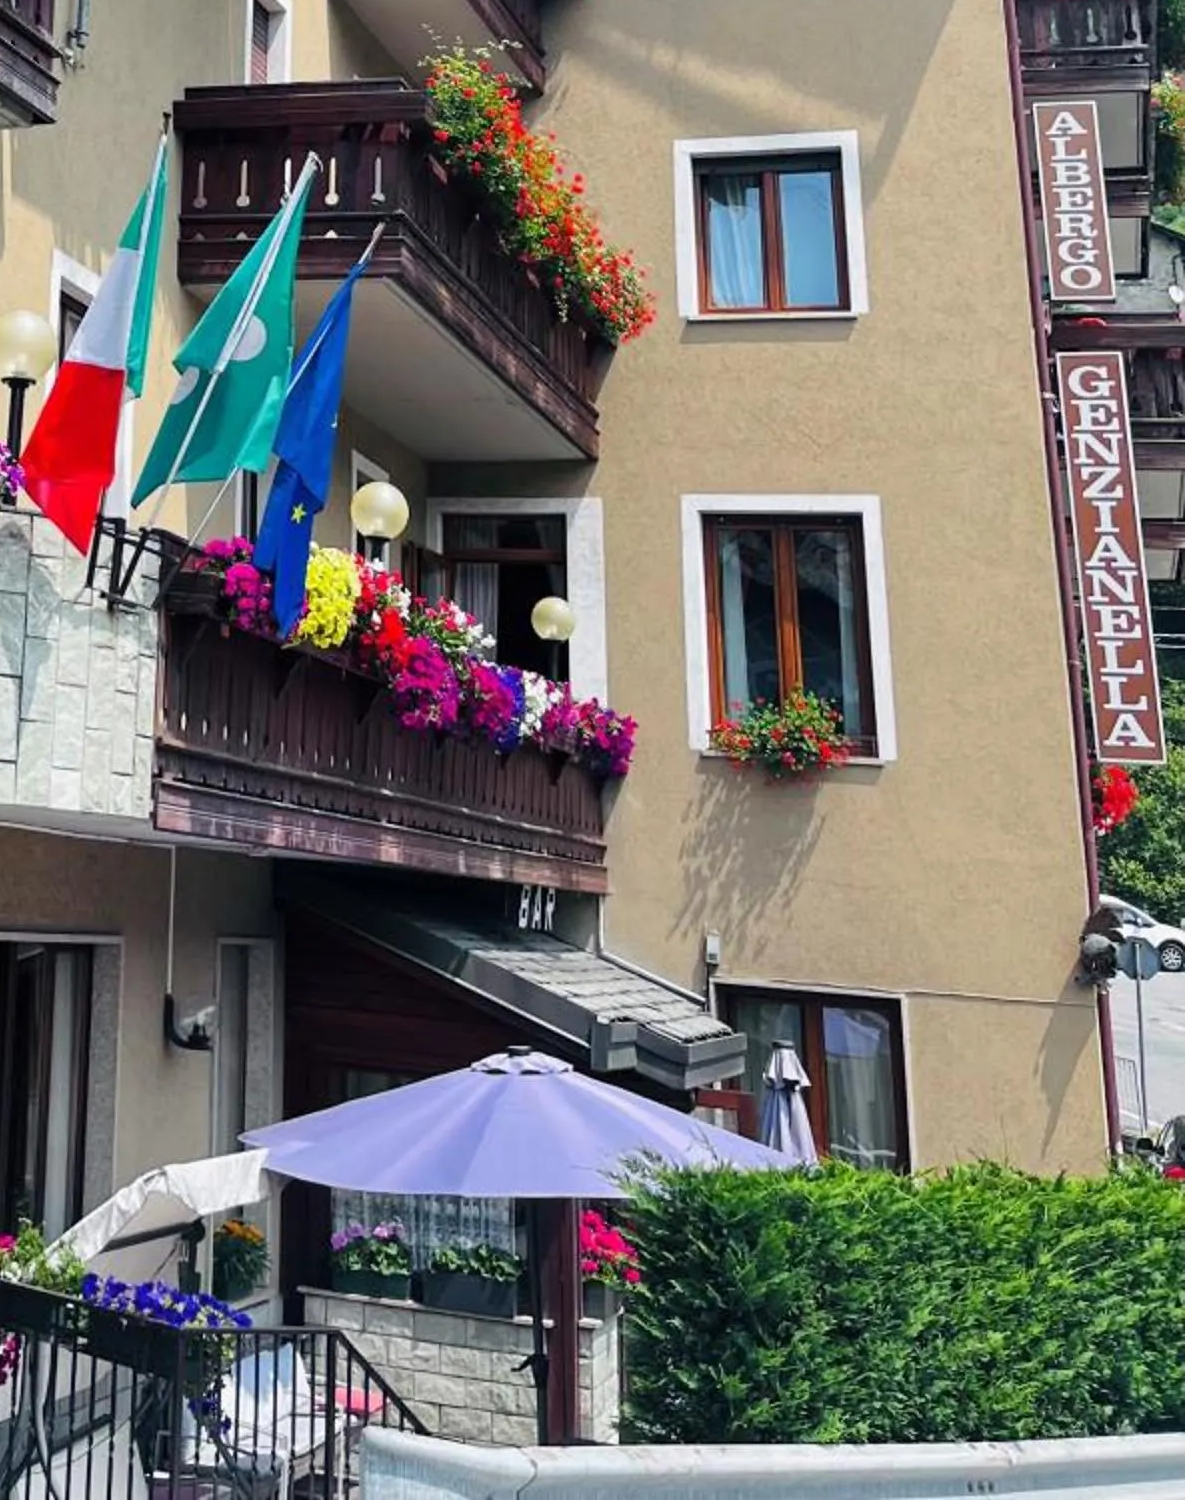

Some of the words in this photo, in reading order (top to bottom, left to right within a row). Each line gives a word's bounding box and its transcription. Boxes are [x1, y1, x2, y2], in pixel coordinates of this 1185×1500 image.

[1044, 111, 1102, 290] ALBERGO
[1067, 365, 1156, 748] GENZIANELLA
[518, 884, 556, 931] BAR
